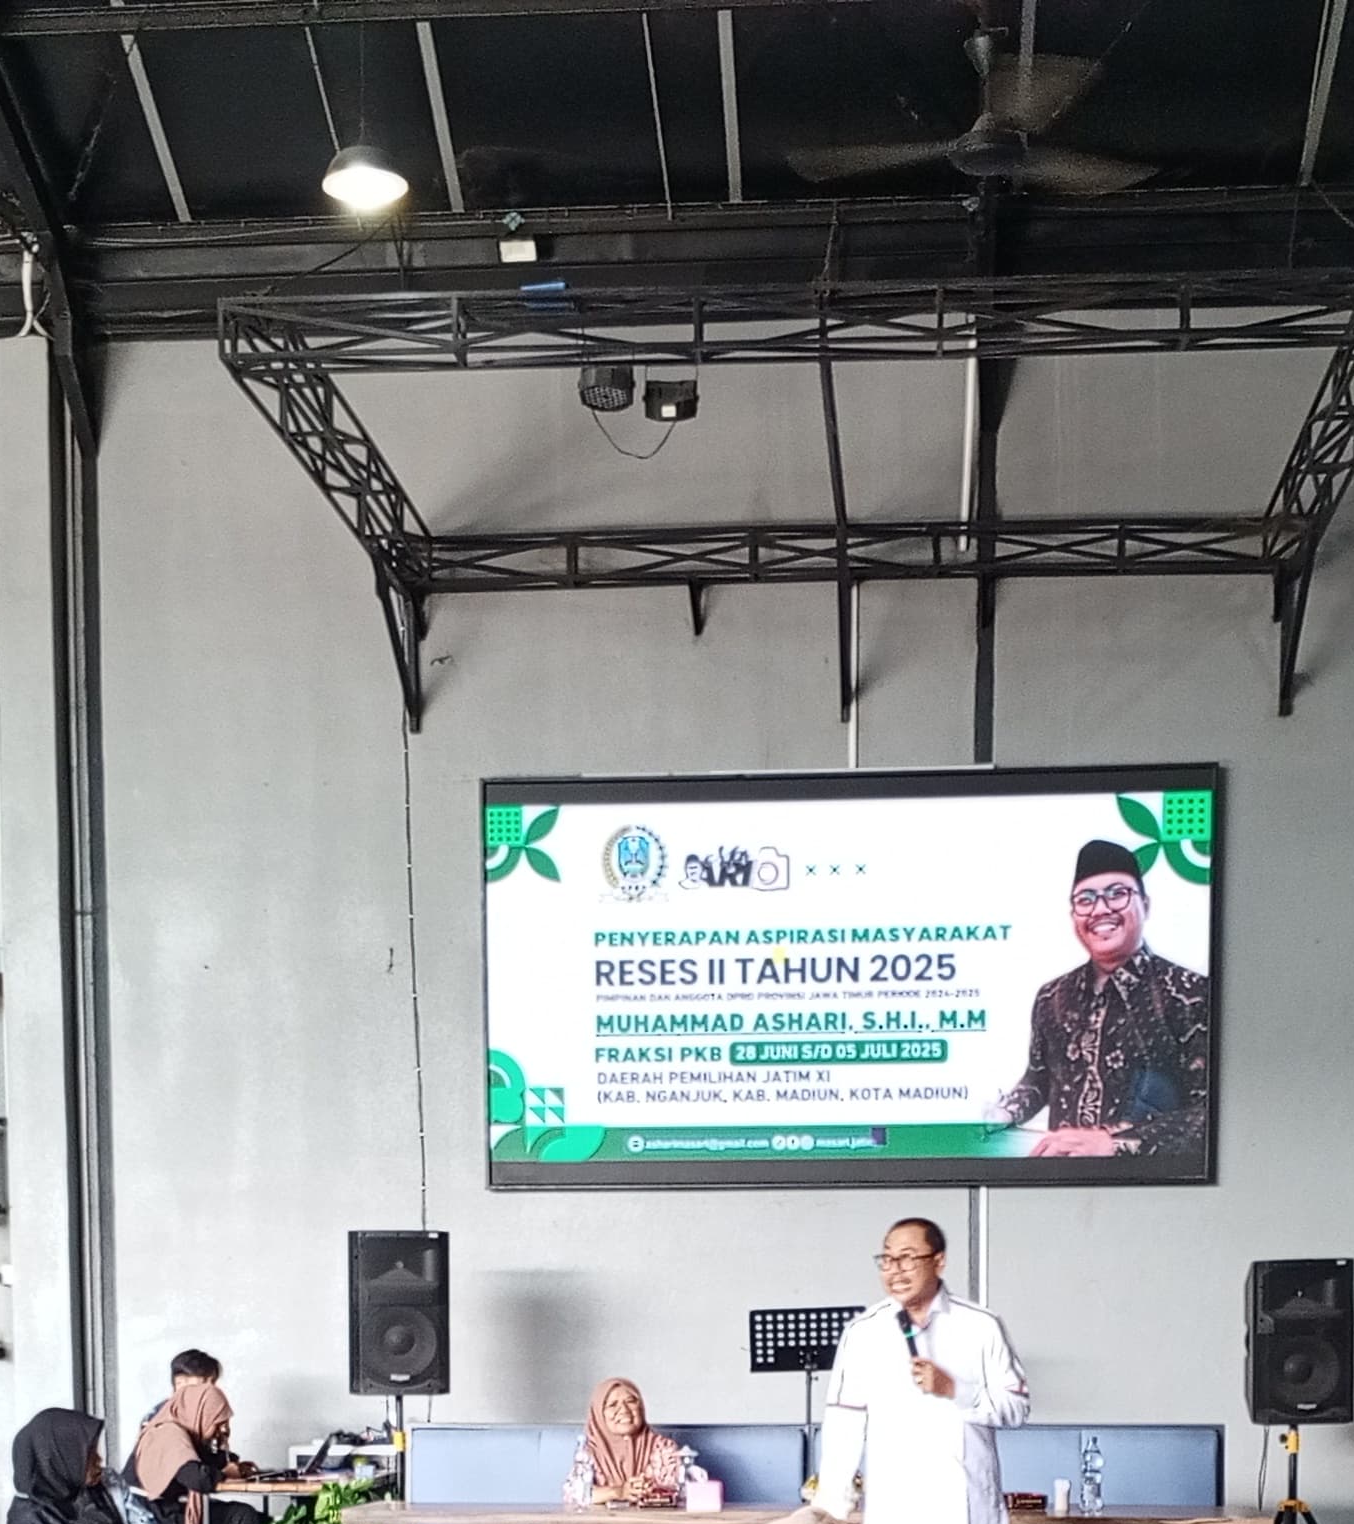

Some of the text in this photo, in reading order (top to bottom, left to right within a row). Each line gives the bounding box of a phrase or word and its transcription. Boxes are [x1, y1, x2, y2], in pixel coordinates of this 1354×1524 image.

[594, 925, 1012, 947] PENYERAPAN ASPIRASI MASYARAKAT
[595, 953, 956, 986] RESES II TAHUN 2025
[649, 993, 671, 1001] DAN
[674, 992, 723, 1001] ANGGOTA
[809, 991, 839, 1000] JAWA
[596, 1013, 744, 1033] MUHAMMAD
[938, 1009, 986, 1029] M.M
[595, 1042, 942, 1063] FRAKSI PKB 28 JUNI S/D 05 JULI 2025
[597, 1070, 831, 1085] DAERAH PEMILIHAN JATIM XI
[597, 1090, 640, 1104] (KAB.
[733, 1089, 770, 1102] KAB.
[849, 1087, 893, 1101] KOTA
[898, 1086, 969, 1101] MADIUN)
